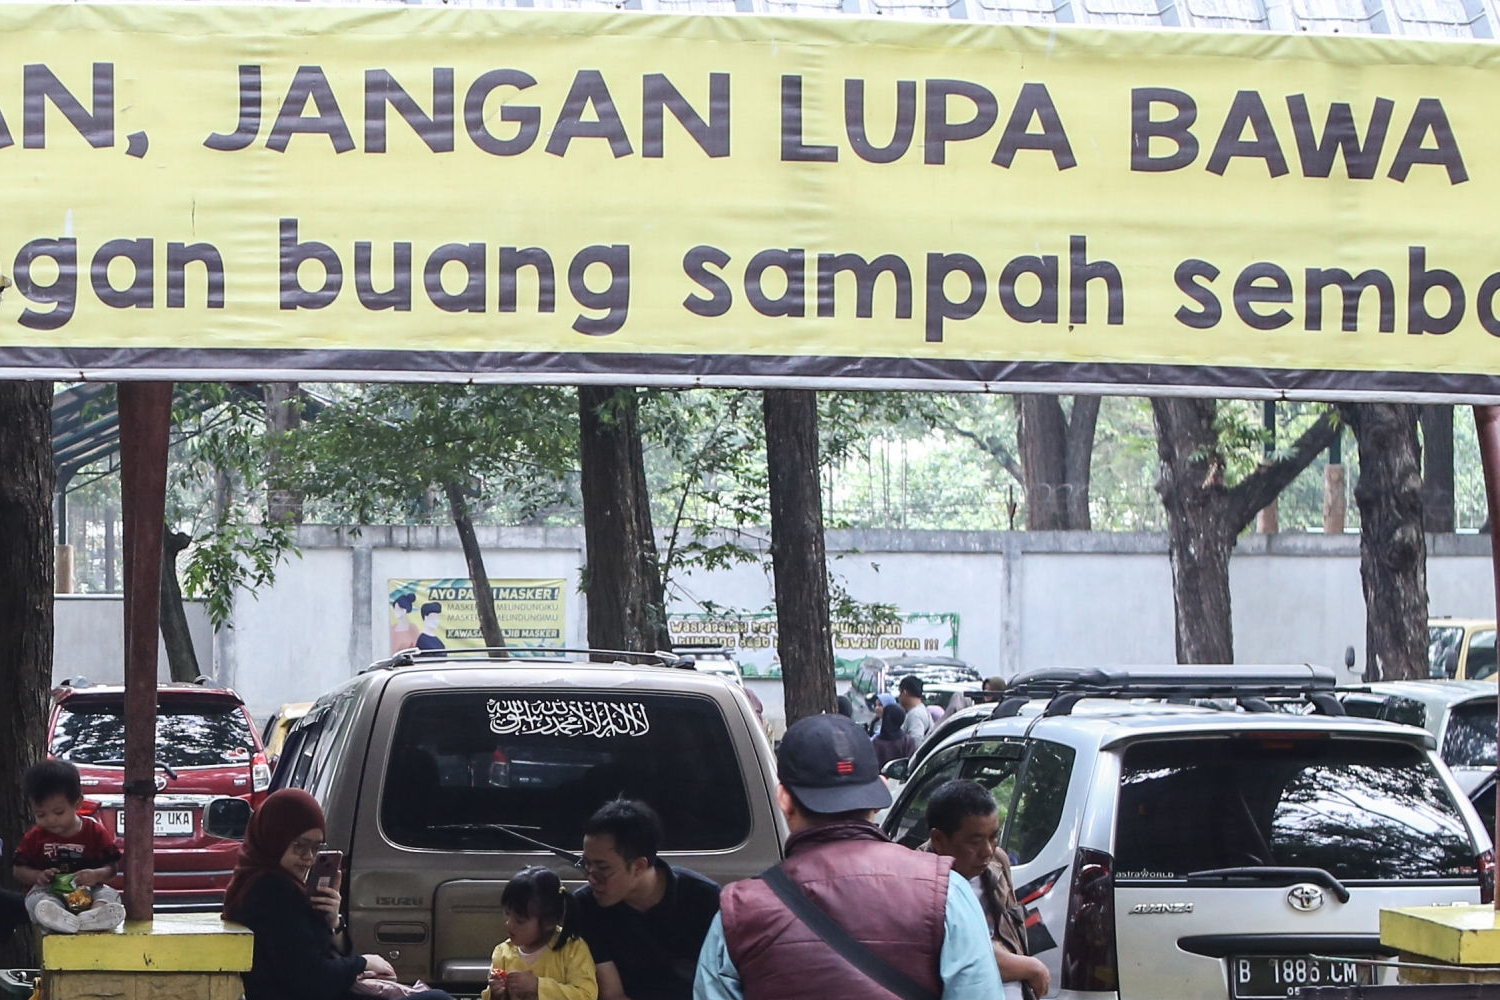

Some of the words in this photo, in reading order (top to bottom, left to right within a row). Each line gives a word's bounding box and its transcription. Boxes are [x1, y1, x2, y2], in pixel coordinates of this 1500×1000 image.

[204, 65, 731, 159] JANGAN
[781, 75, 1078, 171] LUPA
[1131, 88, 1470, 186] BAWA
[279, 219, 630, 336] buang
[683, 236, 1124, 342] sampah
[430, 588, 455, 600] AYO
[501, 588, 550, 600] MASKER
[448, 629, 483, 638] KAWASA
[522, 629, 557, 638] MASKER
[168, 812, 190, 825] UKA
[1128, 902, 1194, 915] AVANZA
[1239, 959, 1251, 983] B
